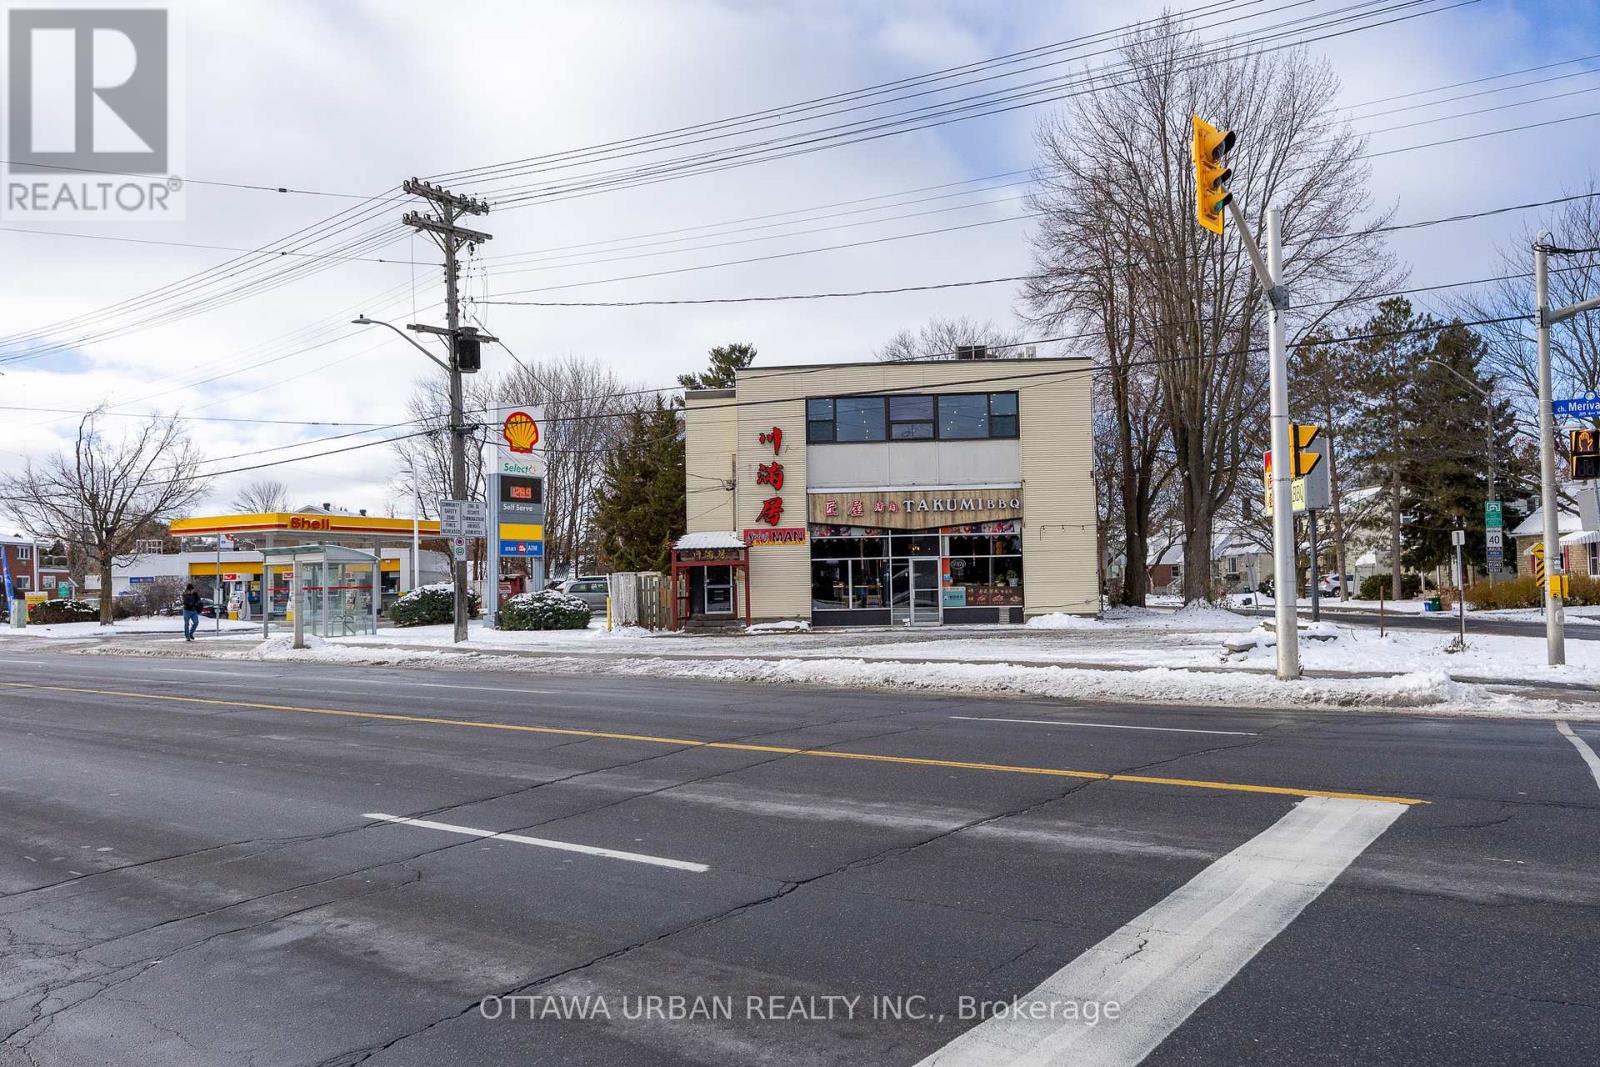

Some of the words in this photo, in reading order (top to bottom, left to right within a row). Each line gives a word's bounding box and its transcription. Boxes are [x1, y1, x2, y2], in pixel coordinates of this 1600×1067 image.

[504, 462, 529, 474] Select
[503, 503, 515, 511] Self
[516, 504, 533, 512] Serve
[903, 498, 983, 513] TAKUMI
[987, 498, 1020, 510] BBQ
[290, 516, 330, 529] Shell
[1489, 535, 1501, 545] 40
